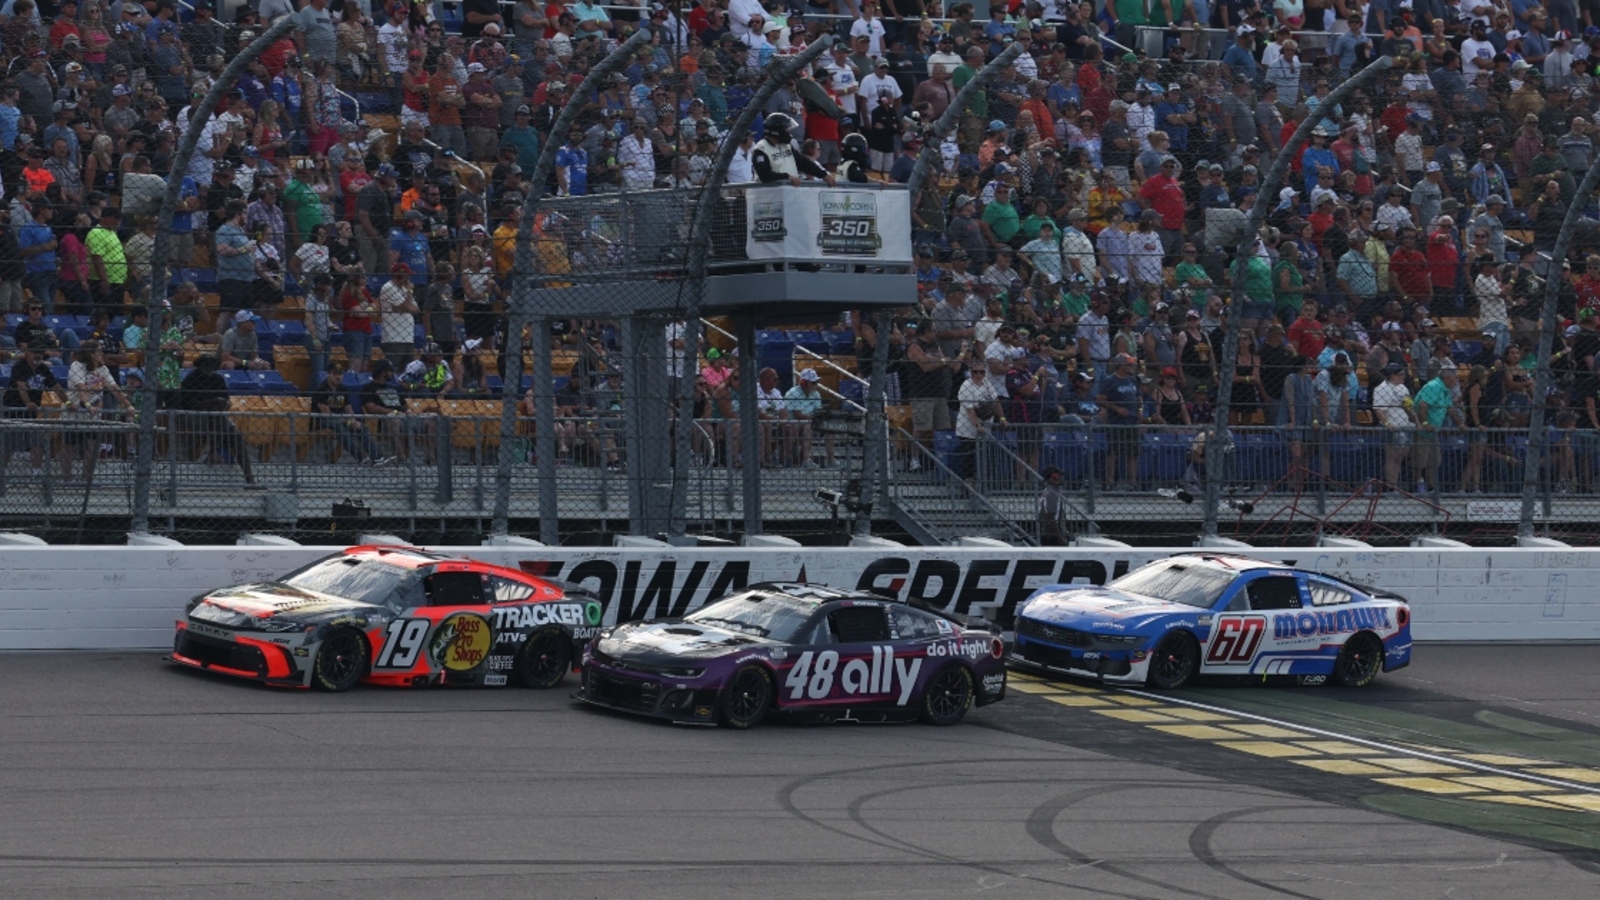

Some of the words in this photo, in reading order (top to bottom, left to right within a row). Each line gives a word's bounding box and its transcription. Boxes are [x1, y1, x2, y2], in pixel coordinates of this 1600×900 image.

[850, 202, 874, 211] CORN
[758, 219, 781, 231] 350
[829, 220, 870, 237] 350
[518, 559, 750, 626] OWA
[455, 616, 480, 633] Bass
[492, 603, 584, 629] TRACKER
[1273, 606, 1392, 640] MOHAWK
[376, 619, 430, 667] 19
[455, 631, 474, 647] Pro
[495, 632, 527, 644] ATVs
[1206, 618, 1265, 662] 60
[452, 646, 483, 666] Shops
[926, 642, 947, 656] do
[948, 641, 959, 656] it
[960, 640, 991, 659] right.
[489, 661, 514, 670] COFFEE
[785, 650, 840, 699] 48
[841, 645, 923, 706] ally
